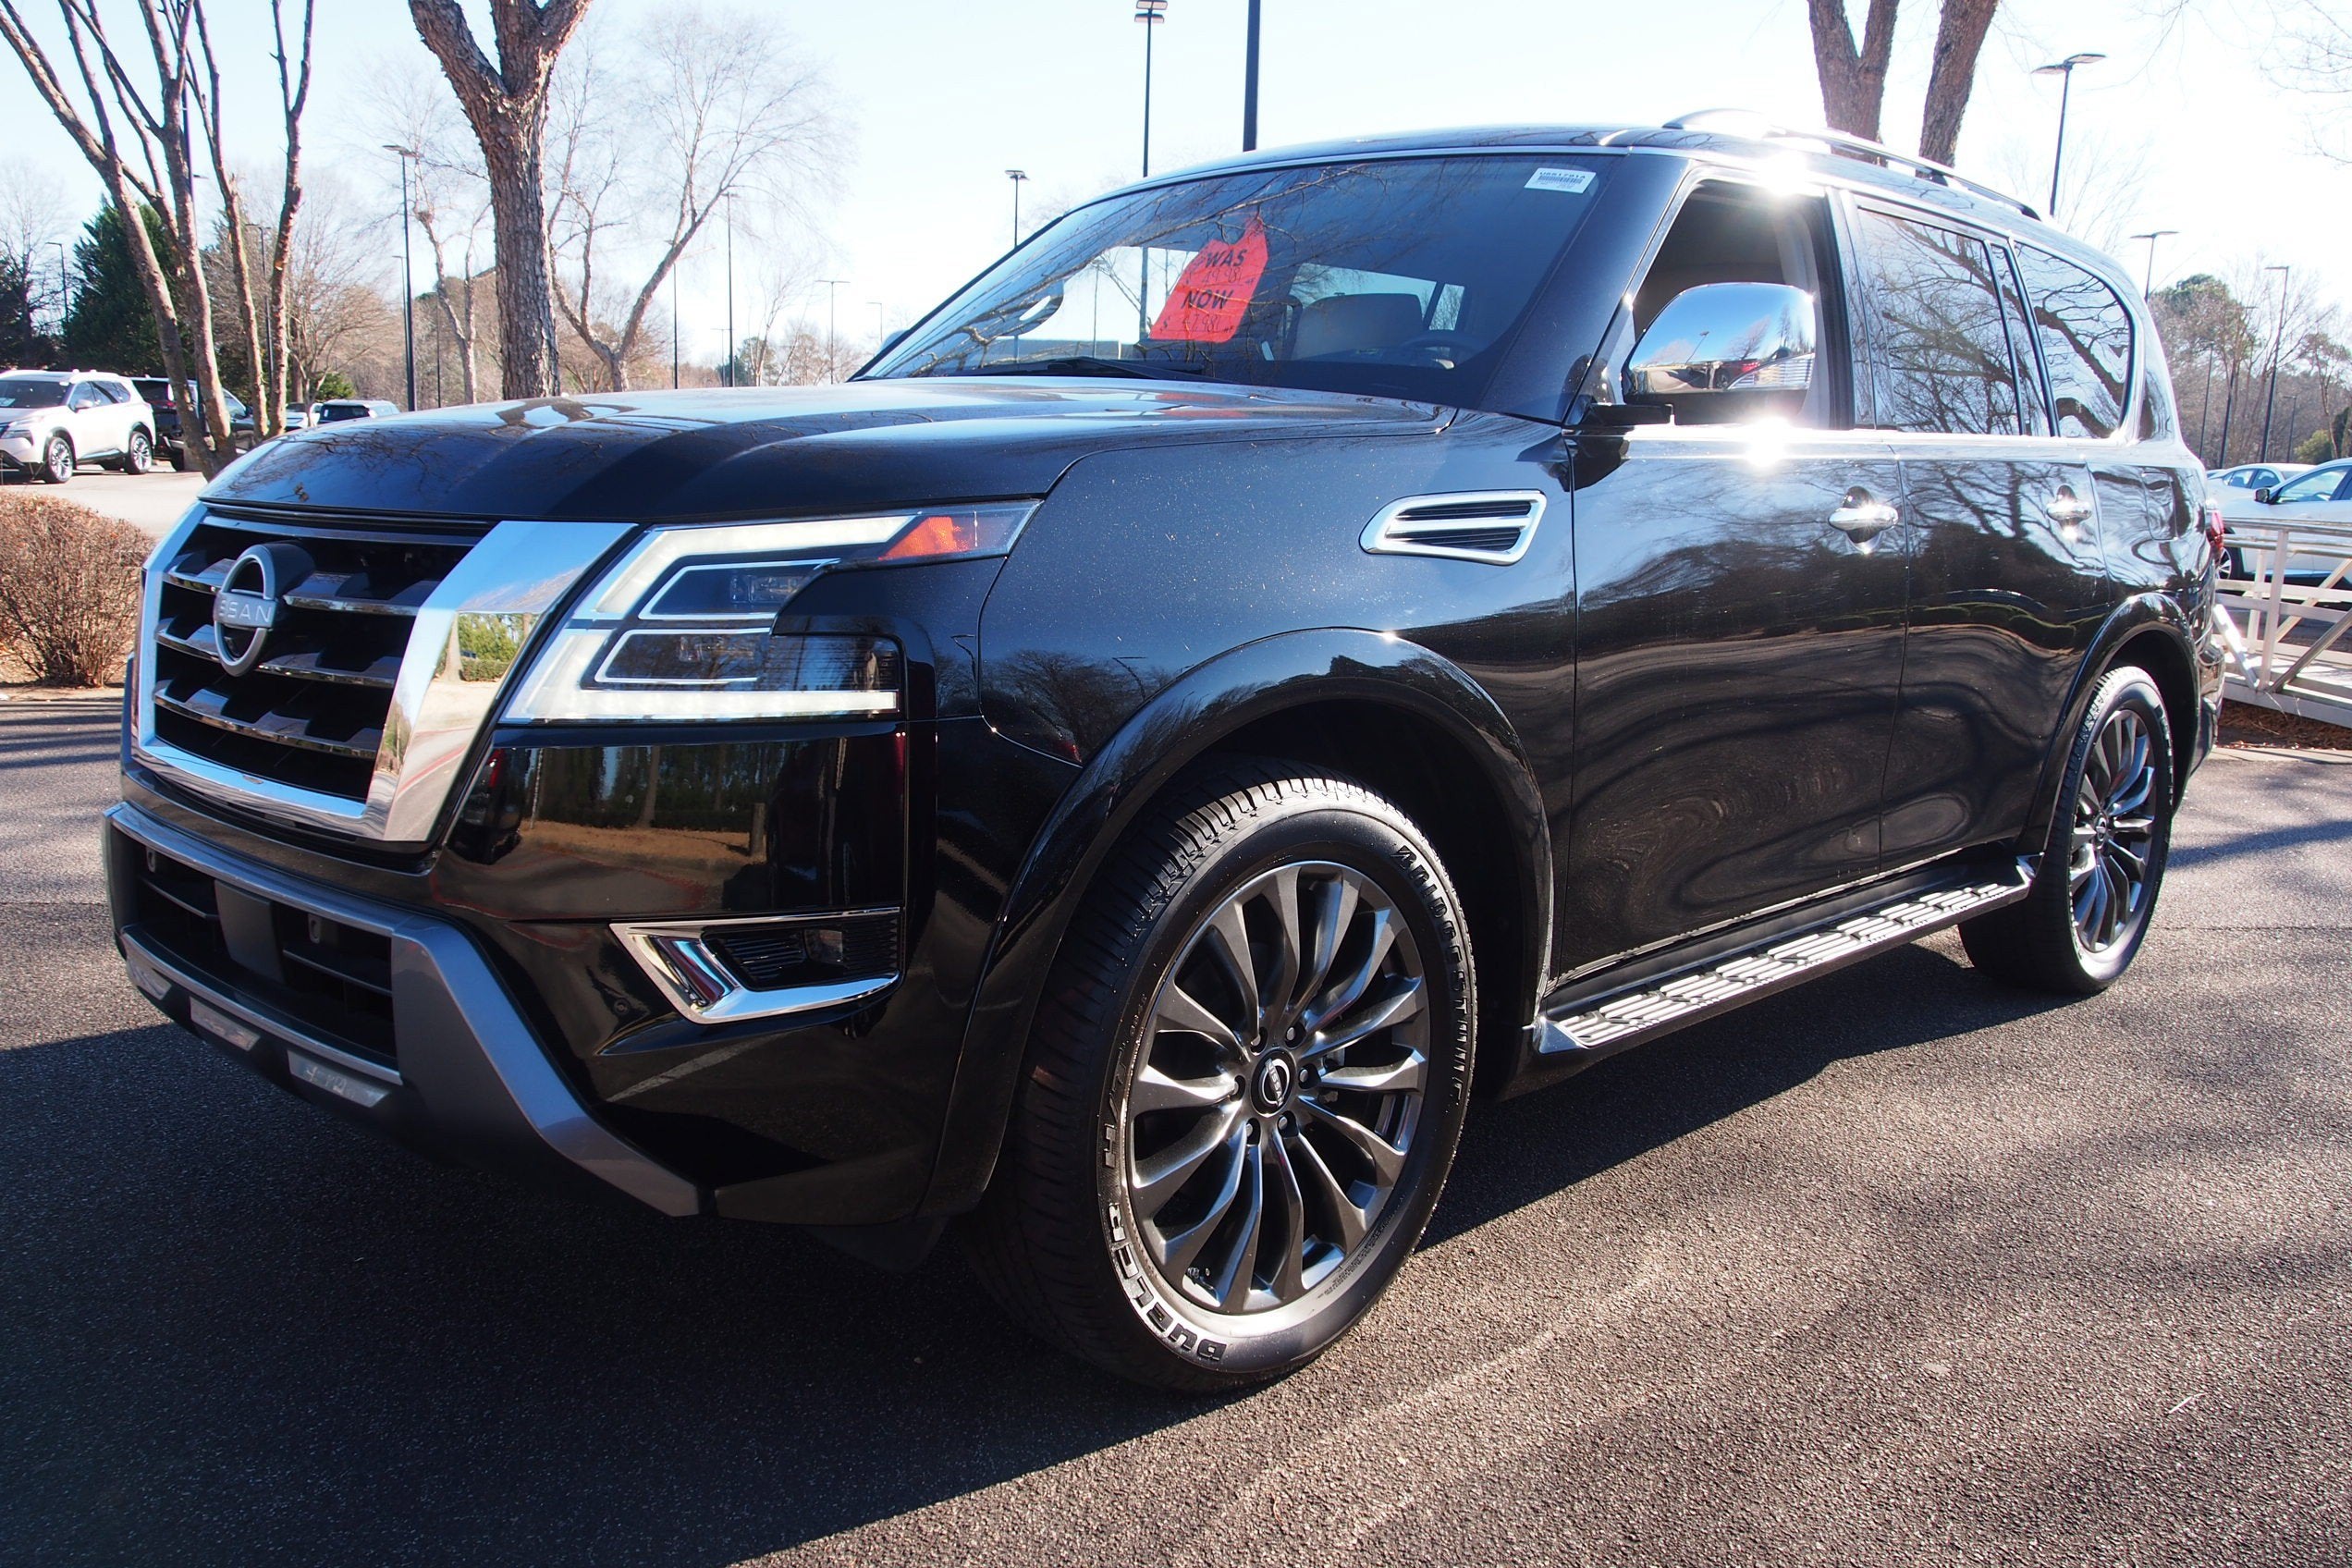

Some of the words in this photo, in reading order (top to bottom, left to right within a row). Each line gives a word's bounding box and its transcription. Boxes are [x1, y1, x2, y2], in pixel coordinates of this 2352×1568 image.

[1205, 248, 1248, 268] WAS
[1181, 288, 1234, 310] NOW
[1109, 1202, 1227, 1362] DUELER
